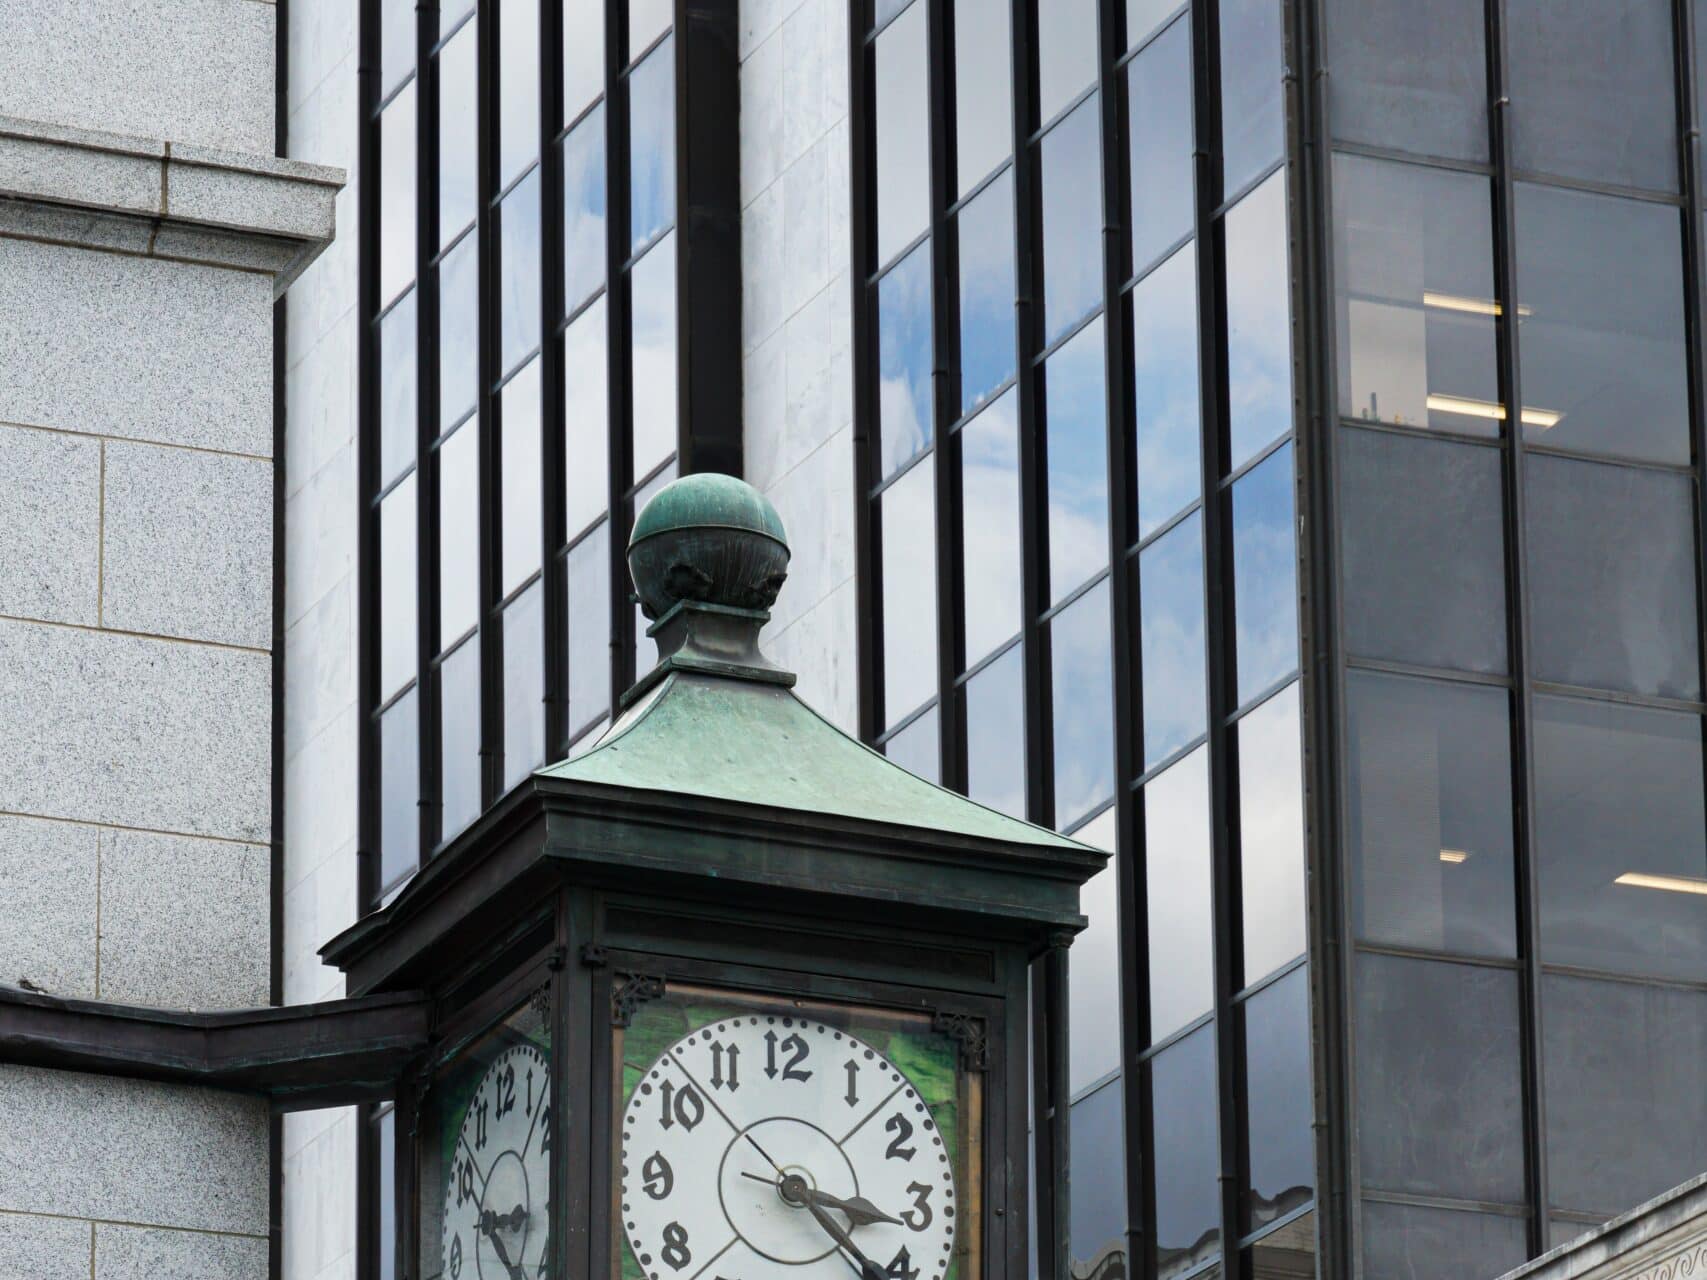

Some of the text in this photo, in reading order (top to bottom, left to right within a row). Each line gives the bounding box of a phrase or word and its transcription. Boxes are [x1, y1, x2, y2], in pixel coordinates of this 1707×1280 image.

[710, 1041, 740, 1092] 11
[764, 1029, 813, 1083] 12
[495, 1062, 516, 1123] 12
[525, 1066, 533, 1119] 1
[657, 1078, 705, 1133] 10
[843, 1058, 860, 1108] 1
[474, 1099, 489, 1153] 11
[884, 1112, 917, 1162] 2
[456, 1157, 475, 1210] 10
[641, 1150, 675, 1201] 9
[899, 1180, 935, 1232] 3
[660, 1221, 692, 1272] 8
